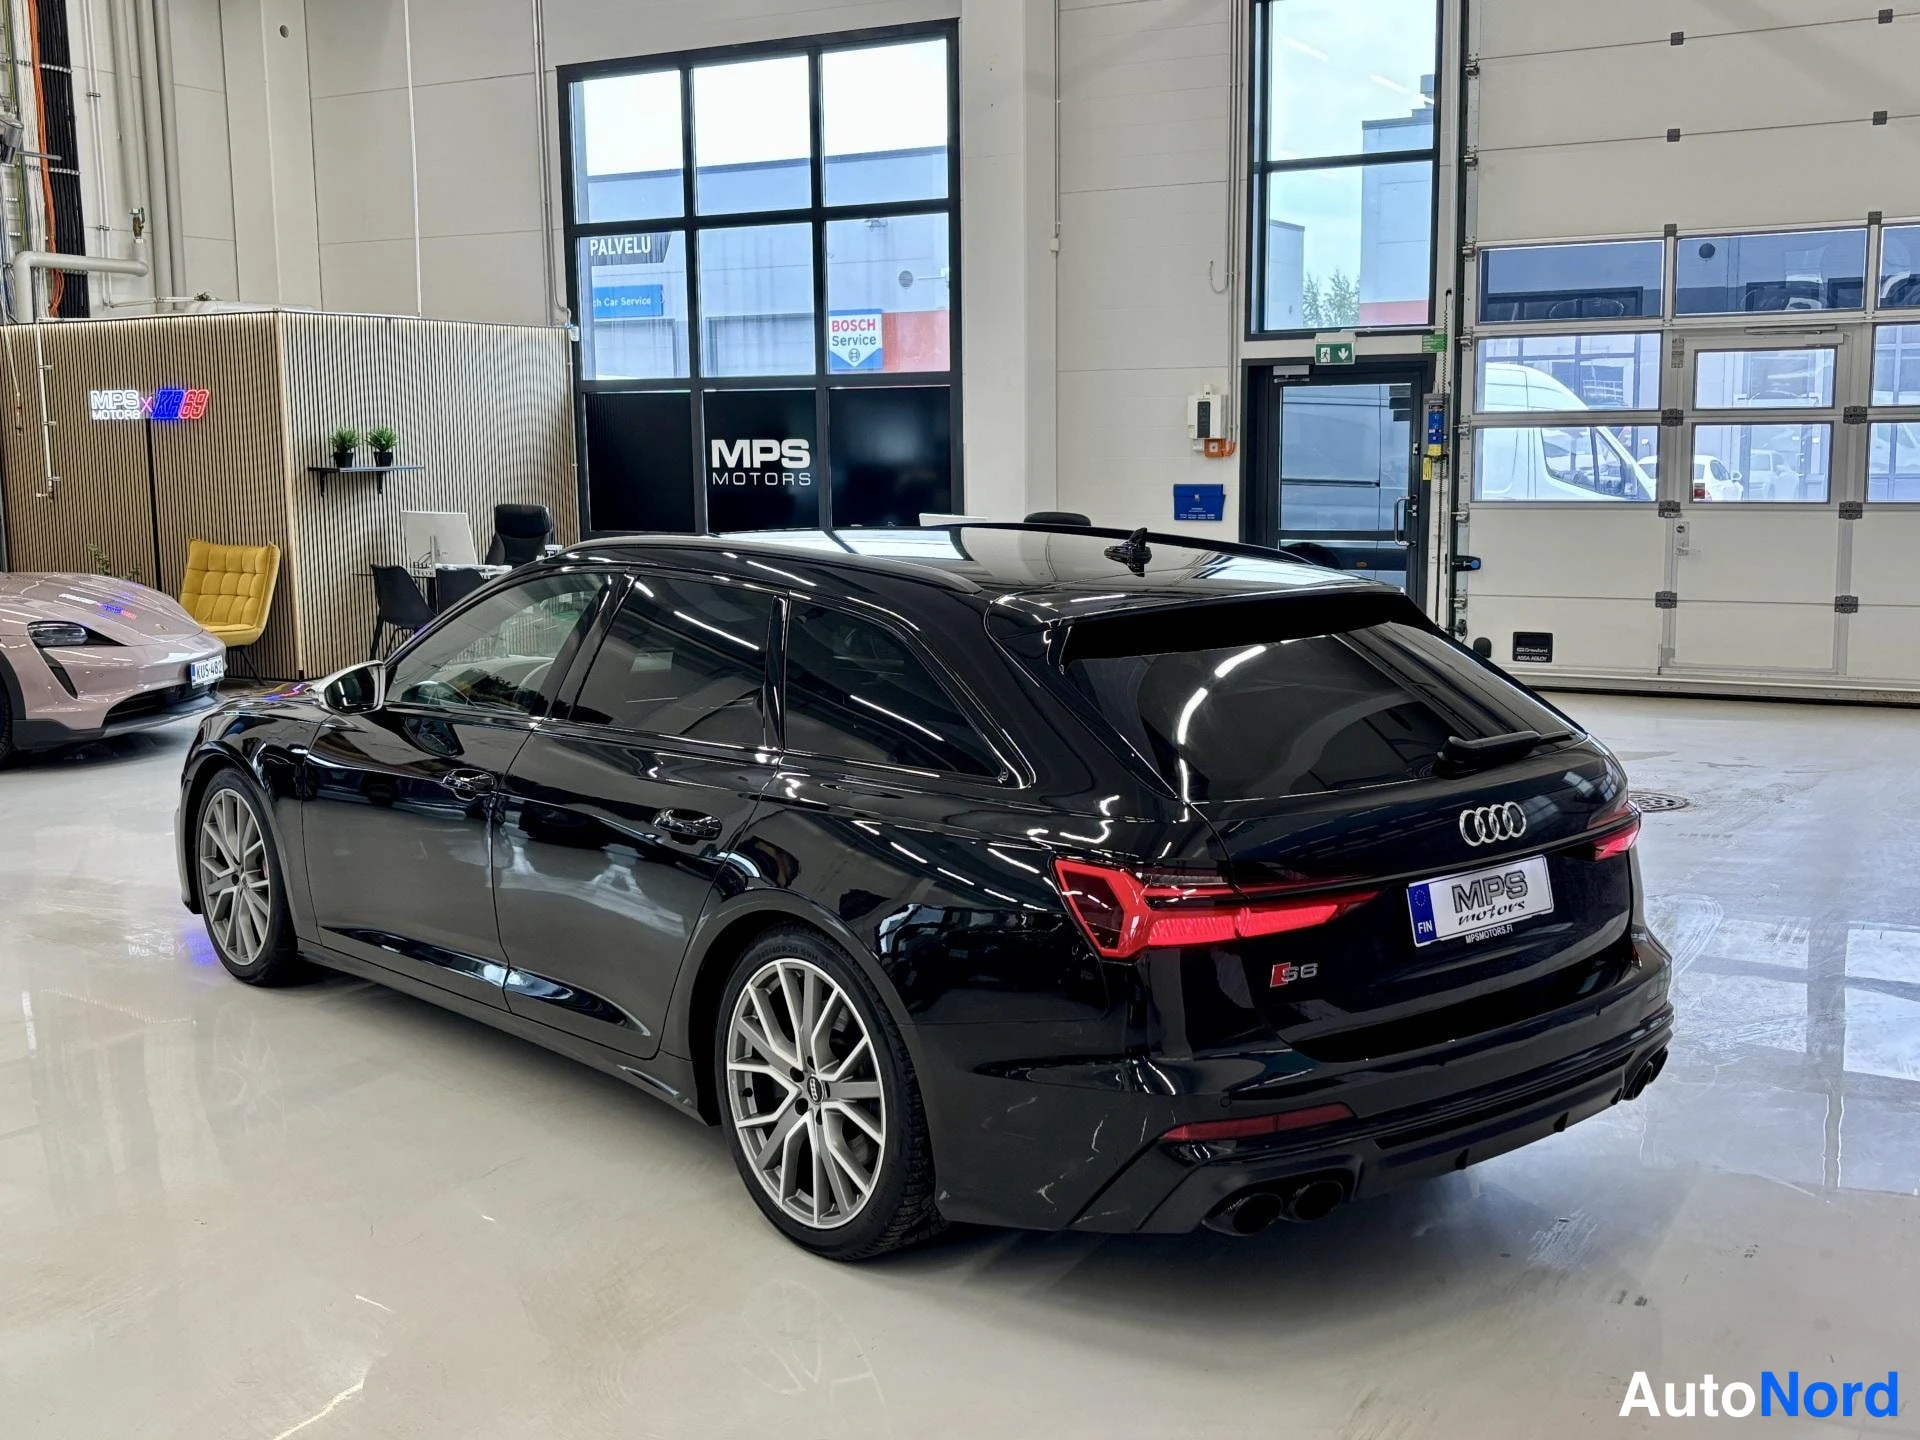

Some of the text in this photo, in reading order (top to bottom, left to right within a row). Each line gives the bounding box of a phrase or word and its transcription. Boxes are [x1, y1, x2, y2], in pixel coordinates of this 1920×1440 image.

[590, 236, 652, 256] PALVELU
[604, 297, 618, 308] Car
[621, 295, 652, 307] Service
[831, 318, 876, 332] BOSCH
[831, 333, 877, 346] Service
[90, 389, 140, 410] MPS
[91, 409, 141, 420] MOTORS
[711, 438, 811, 469] MPS
[712, 471, 811, 486] MOTORS
[1451, 870, 1528, 914] MPS
[1458, 900, 1526, 926] motors
[1417, 919, 1433, 934] FIN
[1465, 924, 1513, 944] MPSMOTORS.FI
[1281, 962, 1319, 982] S6
